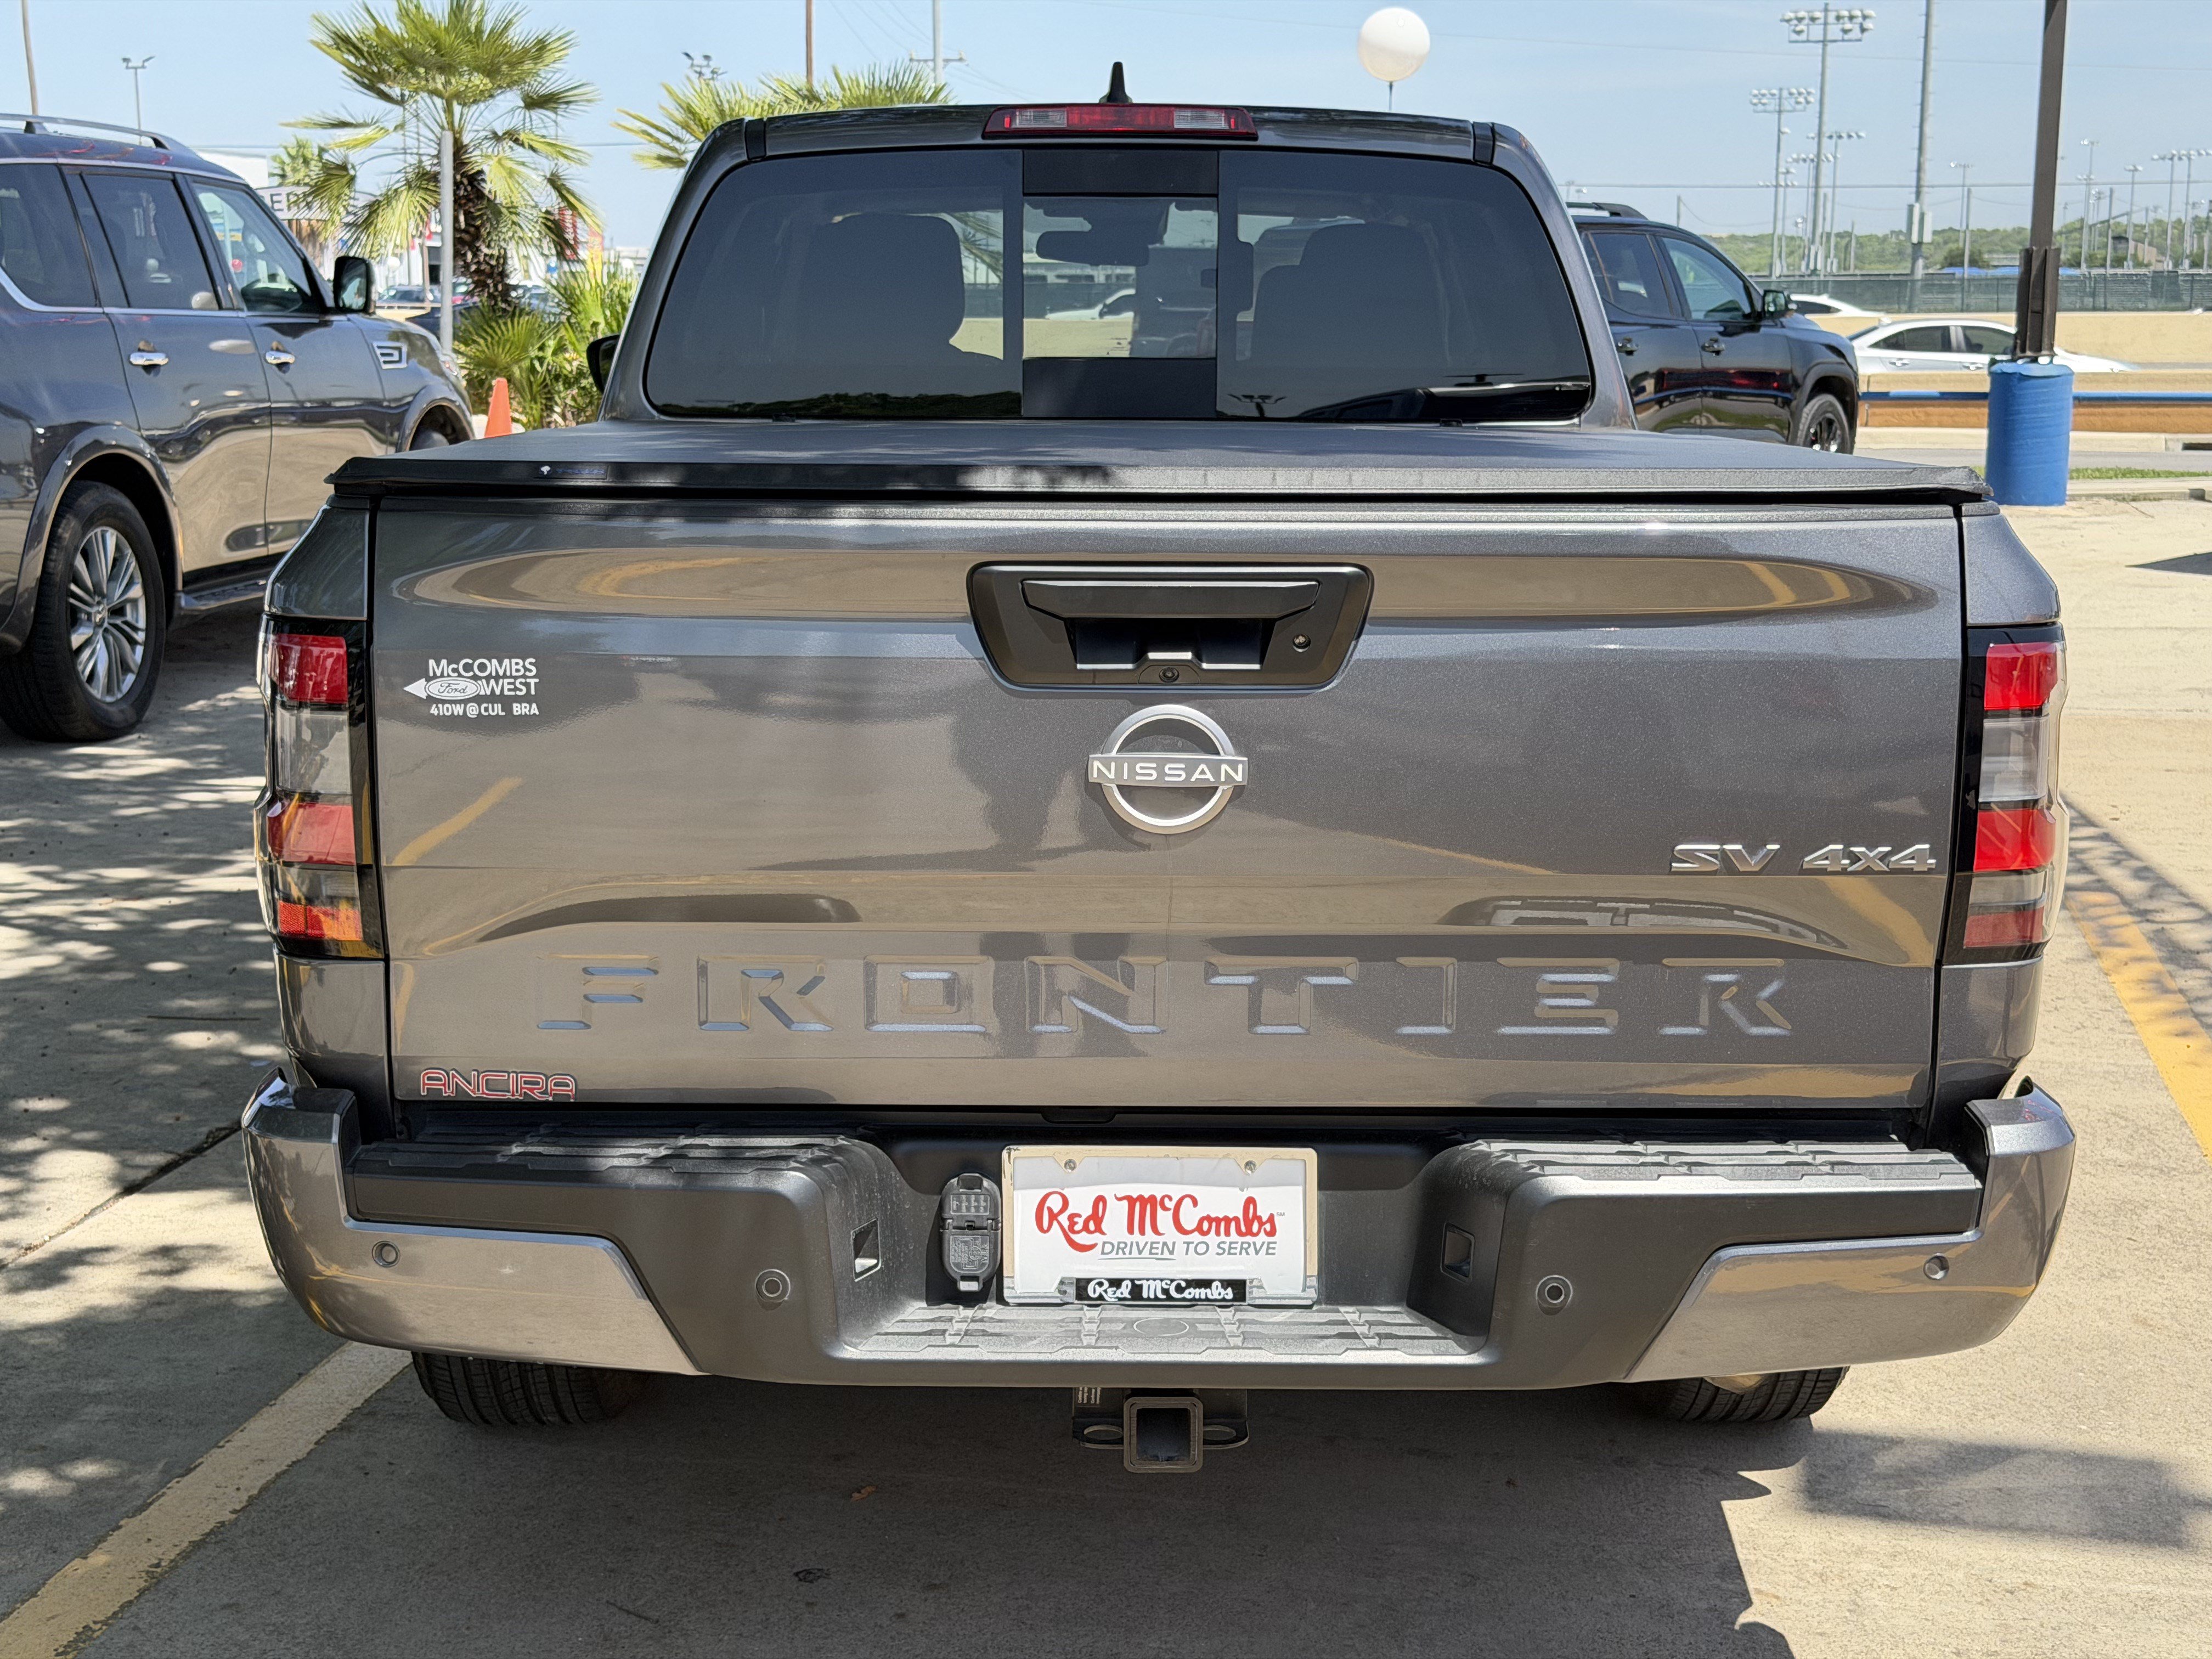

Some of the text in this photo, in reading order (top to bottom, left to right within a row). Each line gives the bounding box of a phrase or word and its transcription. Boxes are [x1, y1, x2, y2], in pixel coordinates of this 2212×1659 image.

[428, 658, 537, 676] McCOMBS
[437, 682, 468, 694] Ford
[479, 678, 539, 695] WEST
[512, 703, 539, 715] BRA
[1093, 760, 1243, 782] NISSAN
[1671, 844, 1780, 872] SV
[537, 955, 1792, 1037] FRONTIER
[421, 1068, 577, 1101] ANCIRA
[1035, 1190, 1107, 1252] Red
[1114, 1193, 1277, 1238] McCombs
[1101, 1241, 1277, 1256] DRIVEN TO SERVE
[1087, 1279, 1233, 1300] Red McCombs
